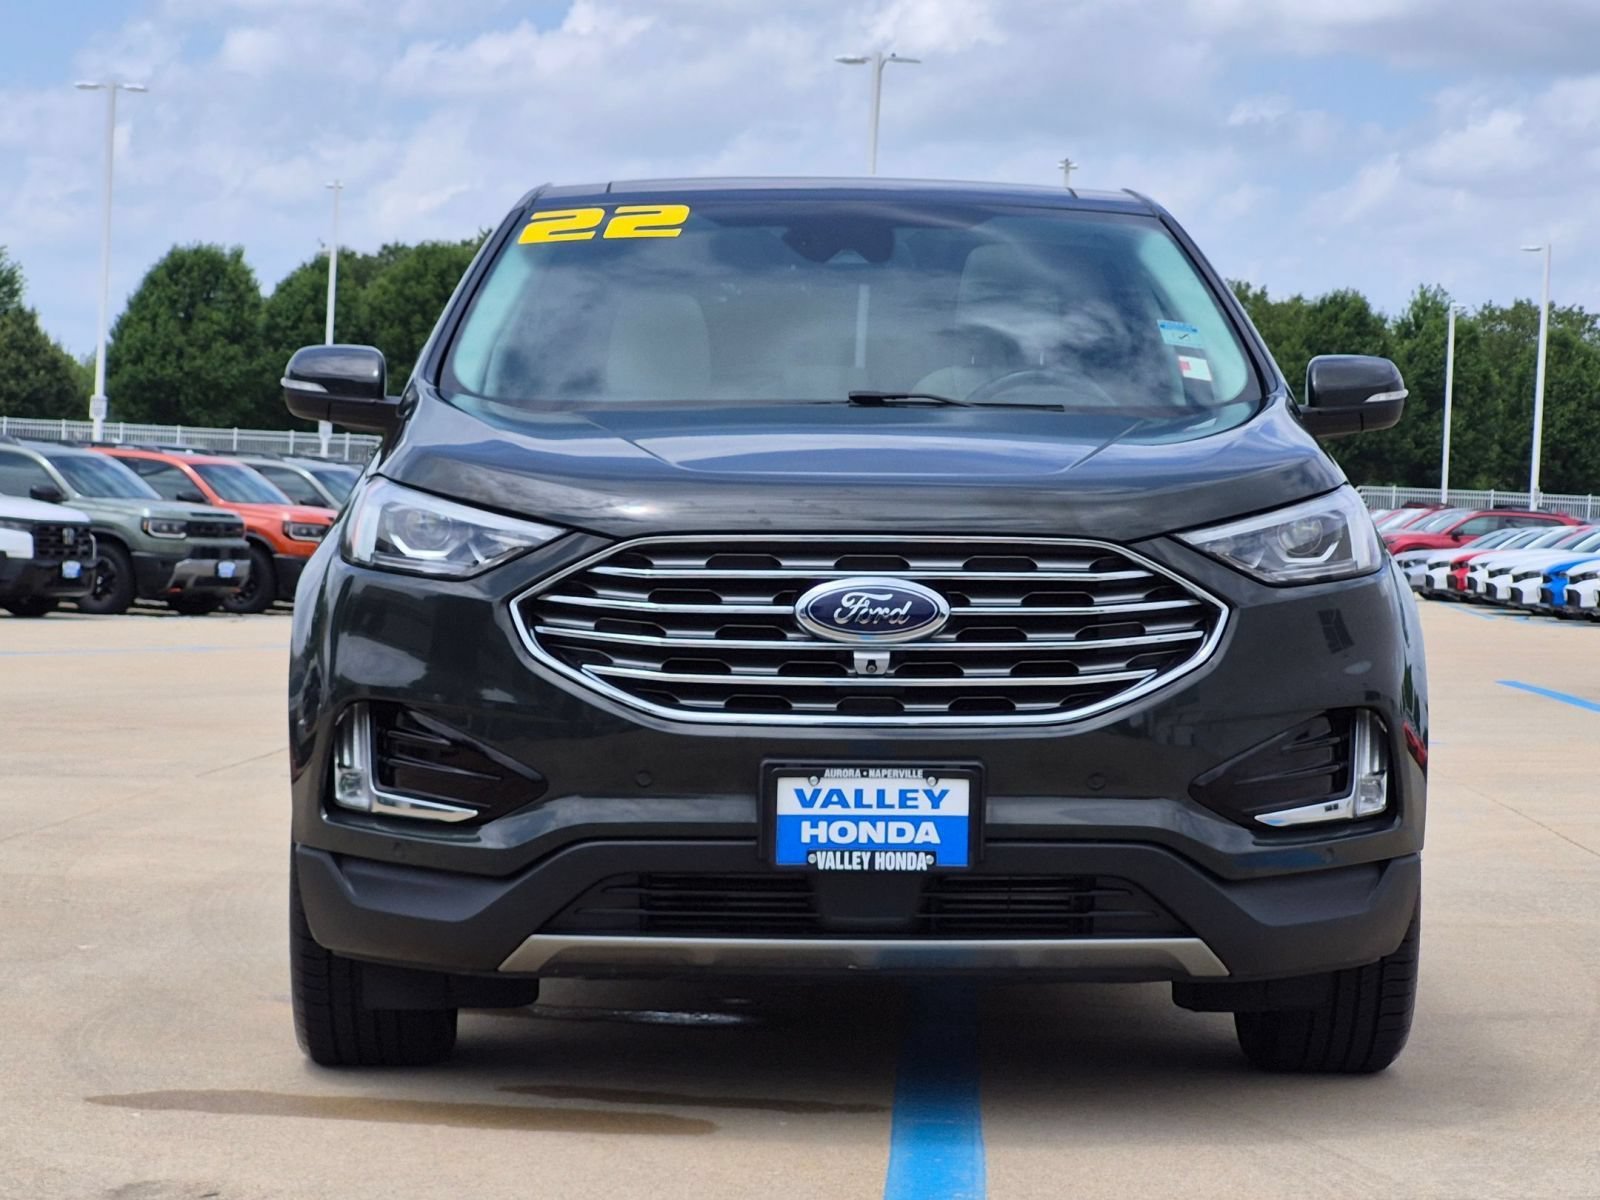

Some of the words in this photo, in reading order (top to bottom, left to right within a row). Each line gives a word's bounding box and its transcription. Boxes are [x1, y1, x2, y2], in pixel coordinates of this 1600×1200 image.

[517, 204, 690, 244] 22
[833, 592, 912, 625] Ford
[824, 768, 861, 778] AURORA
[869, 768, 924, 778] NAPERVILLE
[793, 788, 950, 809] VALLEY
[801, 821, 941, 844] HONDA
[816, 851, 871, 870] VALLEY
[875, 852, 928, 871] HONDA
